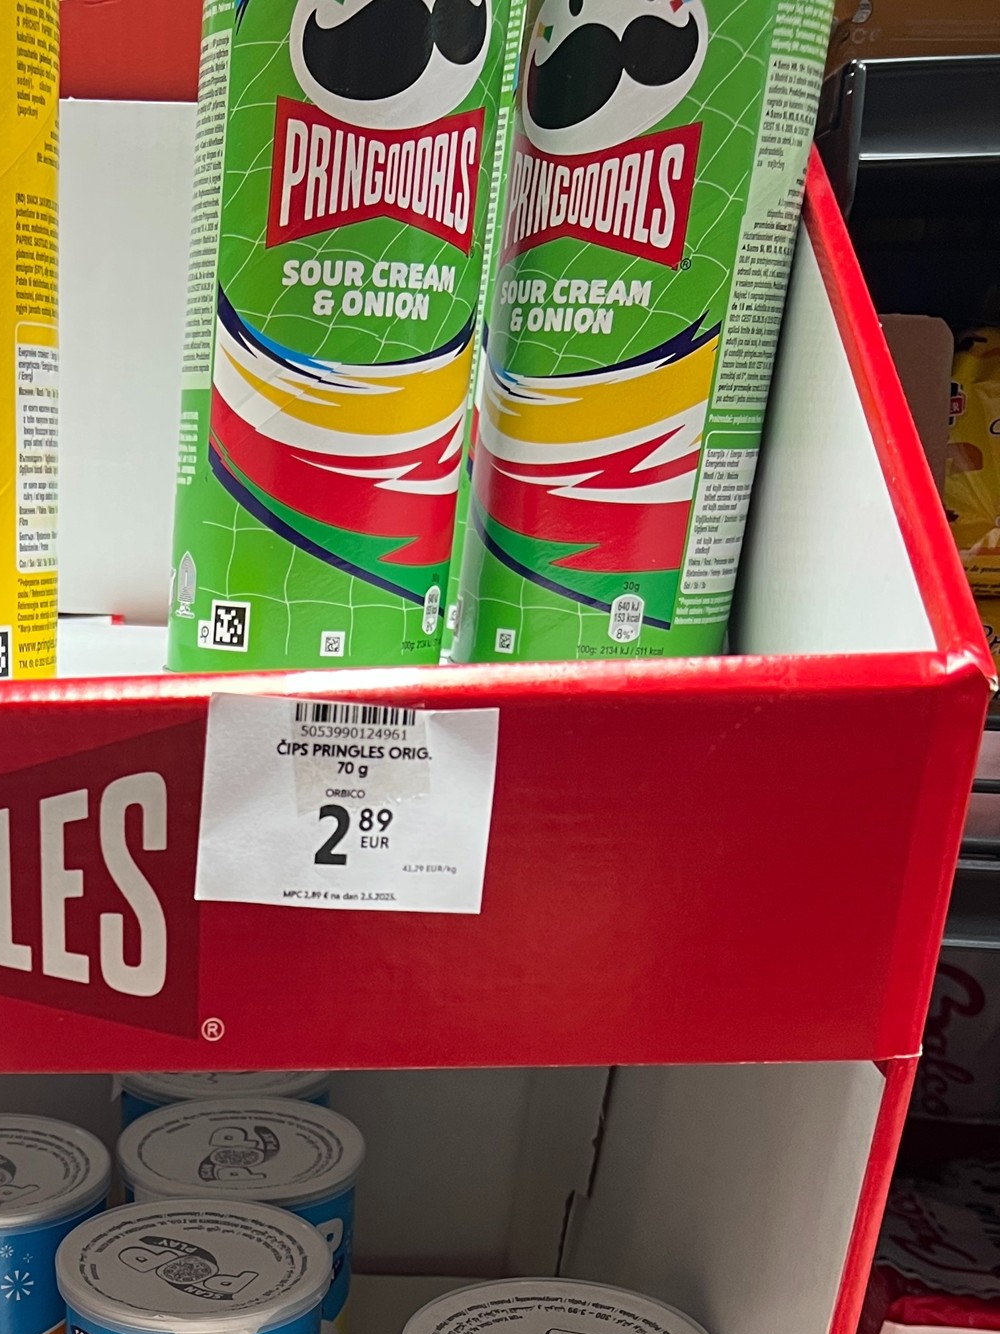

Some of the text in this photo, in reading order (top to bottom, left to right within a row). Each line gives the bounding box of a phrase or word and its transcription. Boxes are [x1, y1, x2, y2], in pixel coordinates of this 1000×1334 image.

[279, 118, 477, 235] PRINGOOOALS
[504, 143, 685, 249] PRINGOOOALS
[282, 259, 456, 293] SOUR CREAM
[312, 289, 430, 321] & ONION
[501, 279, 652, 307] SOUR CREAM
[510, 308, 614, 334] & ONION
[623, 581, 640, 592] 30g
[300, 725, 408, 741] 5053990124961
[276, 740, 432, 761] ČIPS PRINGLES ORIG.
[337, 762, 368, 778] 70 g
[325, 789, 365, 799] ORBICO
[314, 804, 393, 866] 2 89
[361, 836, 389, 849] EUR
